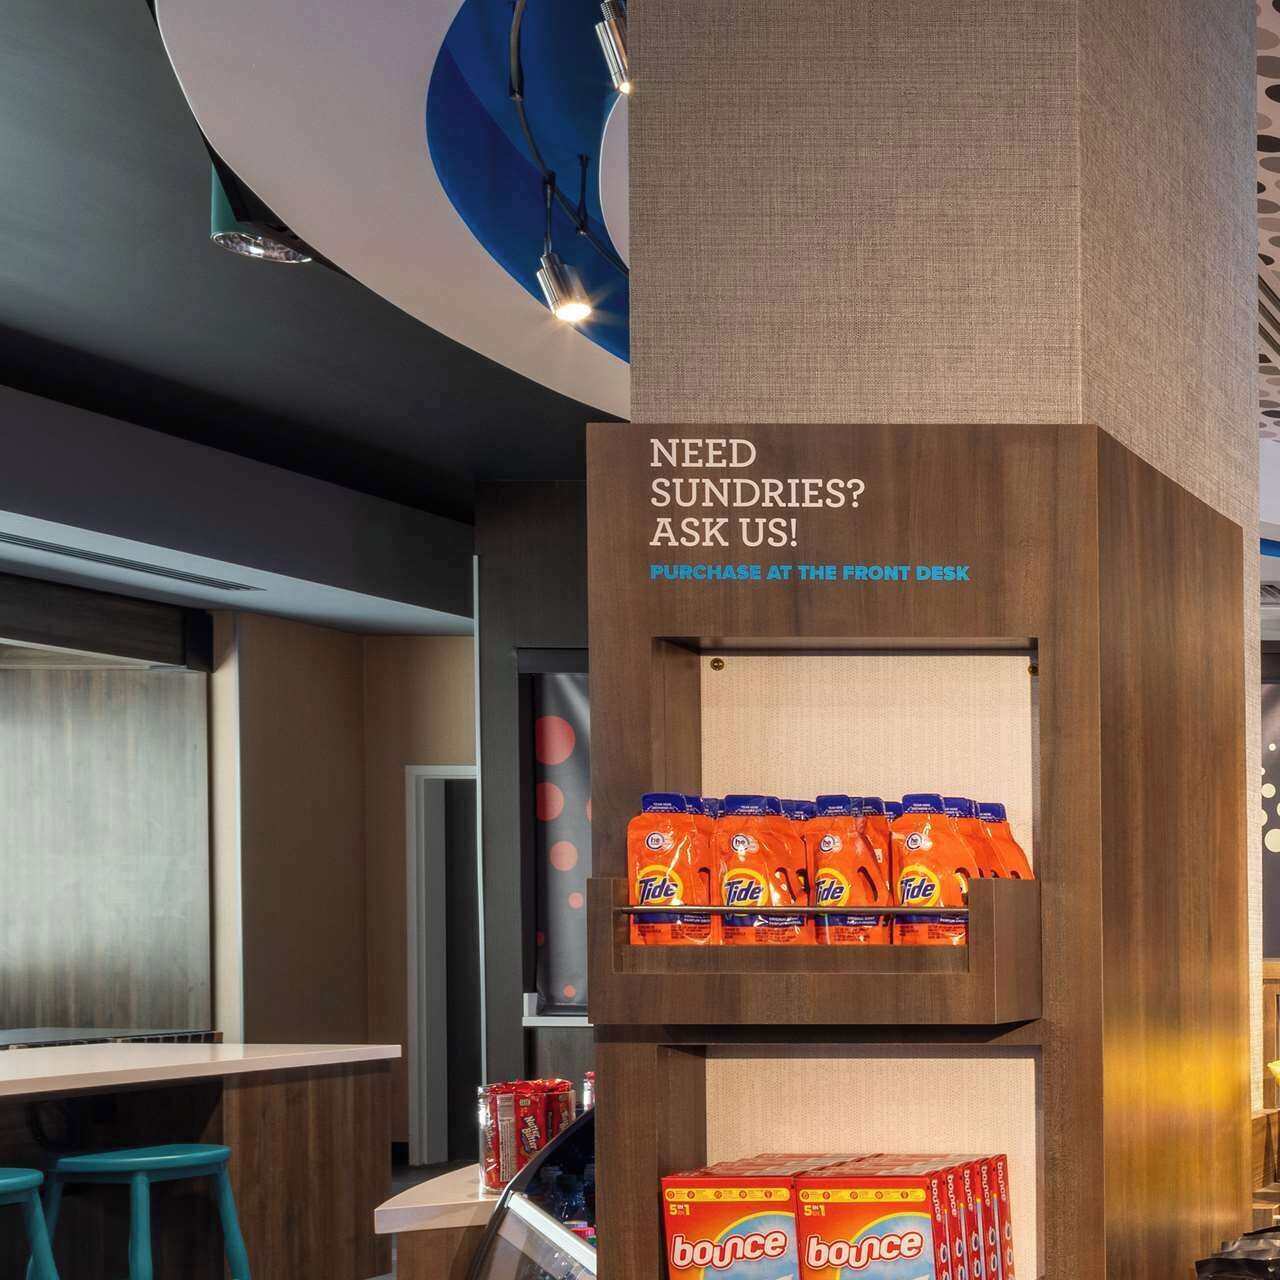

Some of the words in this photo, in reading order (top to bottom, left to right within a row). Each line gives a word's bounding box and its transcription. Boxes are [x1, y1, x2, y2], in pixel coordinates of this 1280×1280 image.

[650, 438, 757, 468] NEED
[650, 477, 865, 509] SUNDRIES?
[649, 517, 729, 548] ASK
[740, 517, 799, 548] US!
[650, 564, 763, 581] PURCHASE
[767, 565, 793, 581] AT
[799, 565, 838, 581] THE
[843, 565, 911, 581] FRONT
[916, 566, 970, 582] DESK
[725, 878, 764, 907] Tide
[900, 876, 936, 905] Tide
[521, 1128, 538, 1150] Butter
[523, 1115, 541, 1138] Nutter
[931, 1179, 942, 1222] bounce
[671, 1230, 788, 1270] bounce
[806, 1231, 924, 1269] bounce
